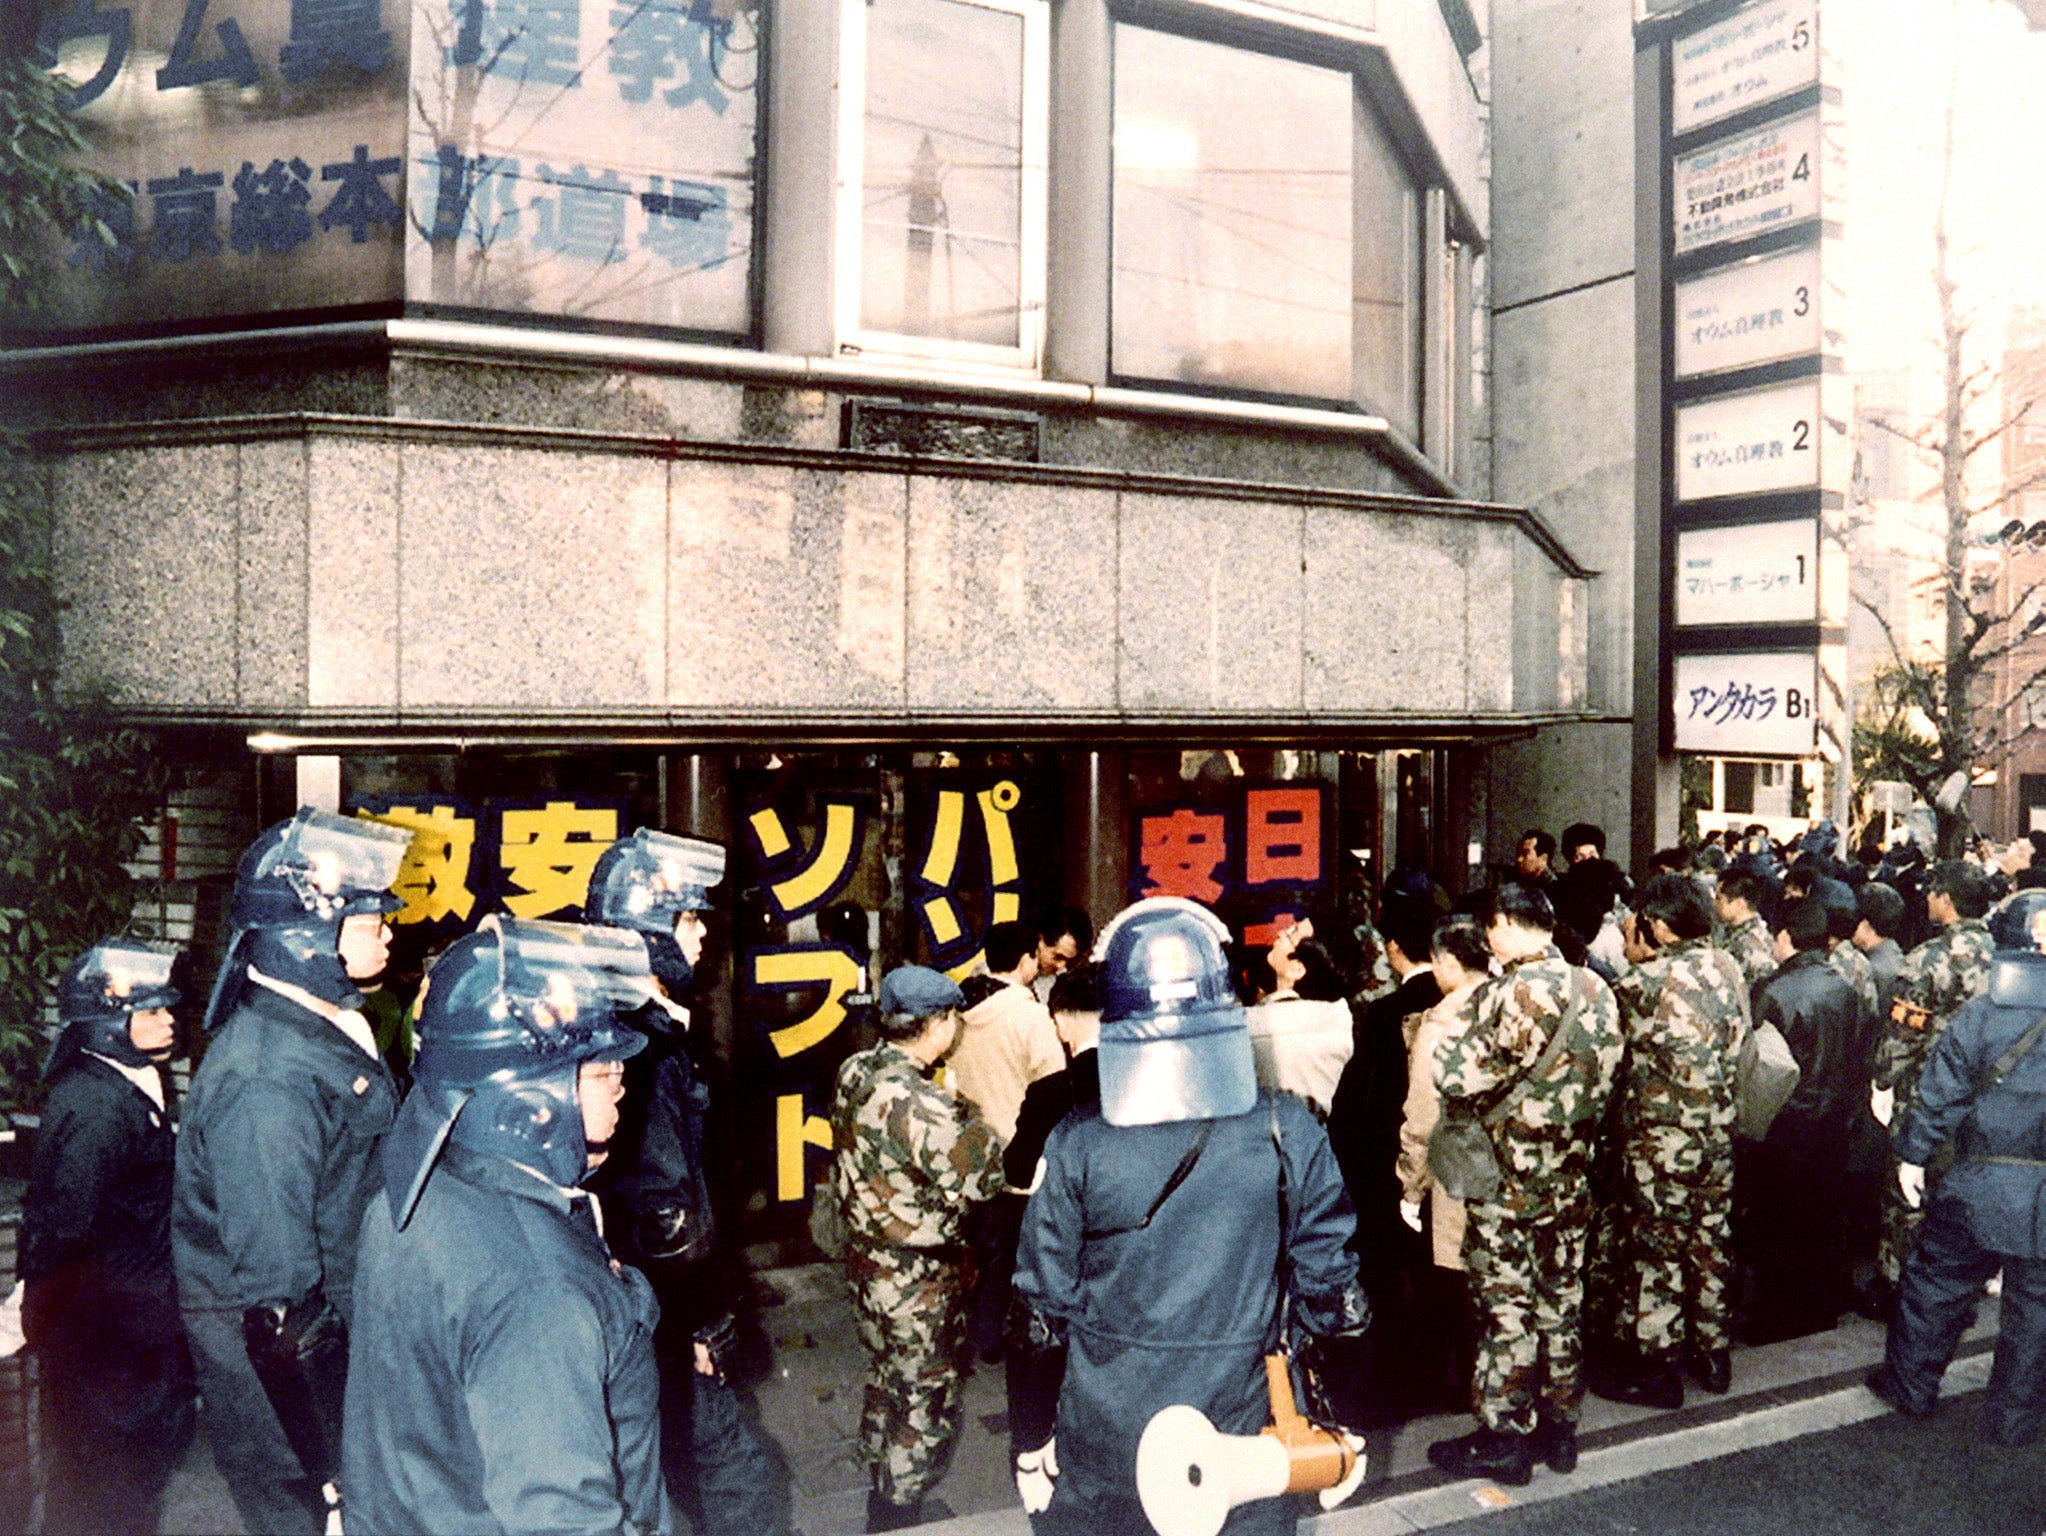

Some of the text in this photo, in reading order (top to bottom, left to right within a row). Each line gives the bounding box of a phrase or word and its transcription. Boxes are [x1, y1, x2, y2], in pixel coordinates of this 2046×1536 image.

[1792, 20, 1810, 52] 5
[1792, 152, 1810, 182] 4
[1794, 286, 1810, 317] 3
[1793, 420, 1810, 451] 2
[1796, 554, 1805, 585] 1
[1786, 688, 1810, 718] B1
[750, 803, 865, 1202] ソフト
